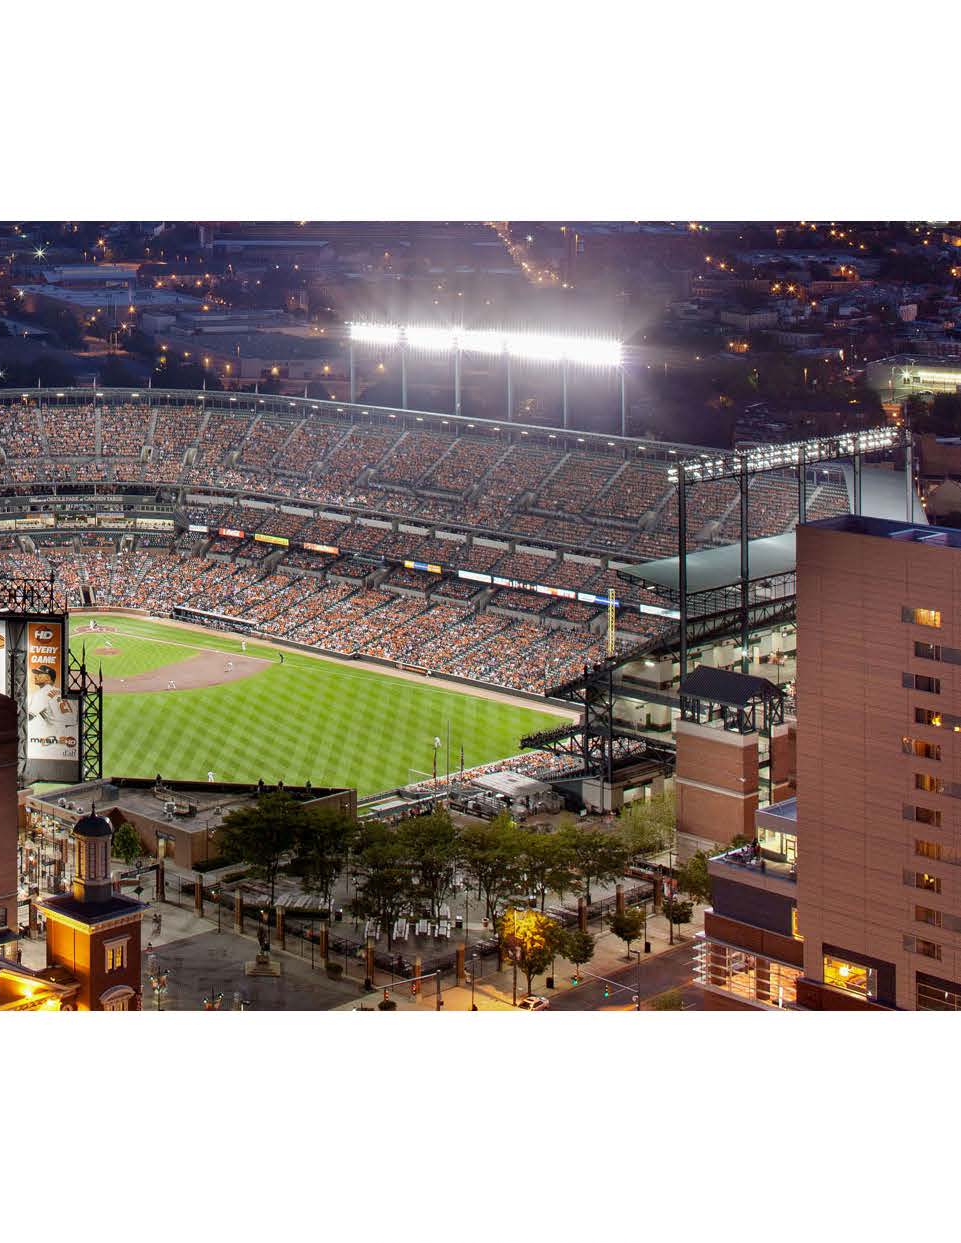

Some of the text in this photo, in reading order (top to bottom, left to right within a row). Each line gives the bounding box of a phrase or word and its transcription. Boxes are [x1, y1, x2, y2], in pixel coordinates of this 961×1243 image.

[34, 630, 54, 640] HD
[31, 645, 58, 654] EVERY
[31, 655, 57, 664] GAME
